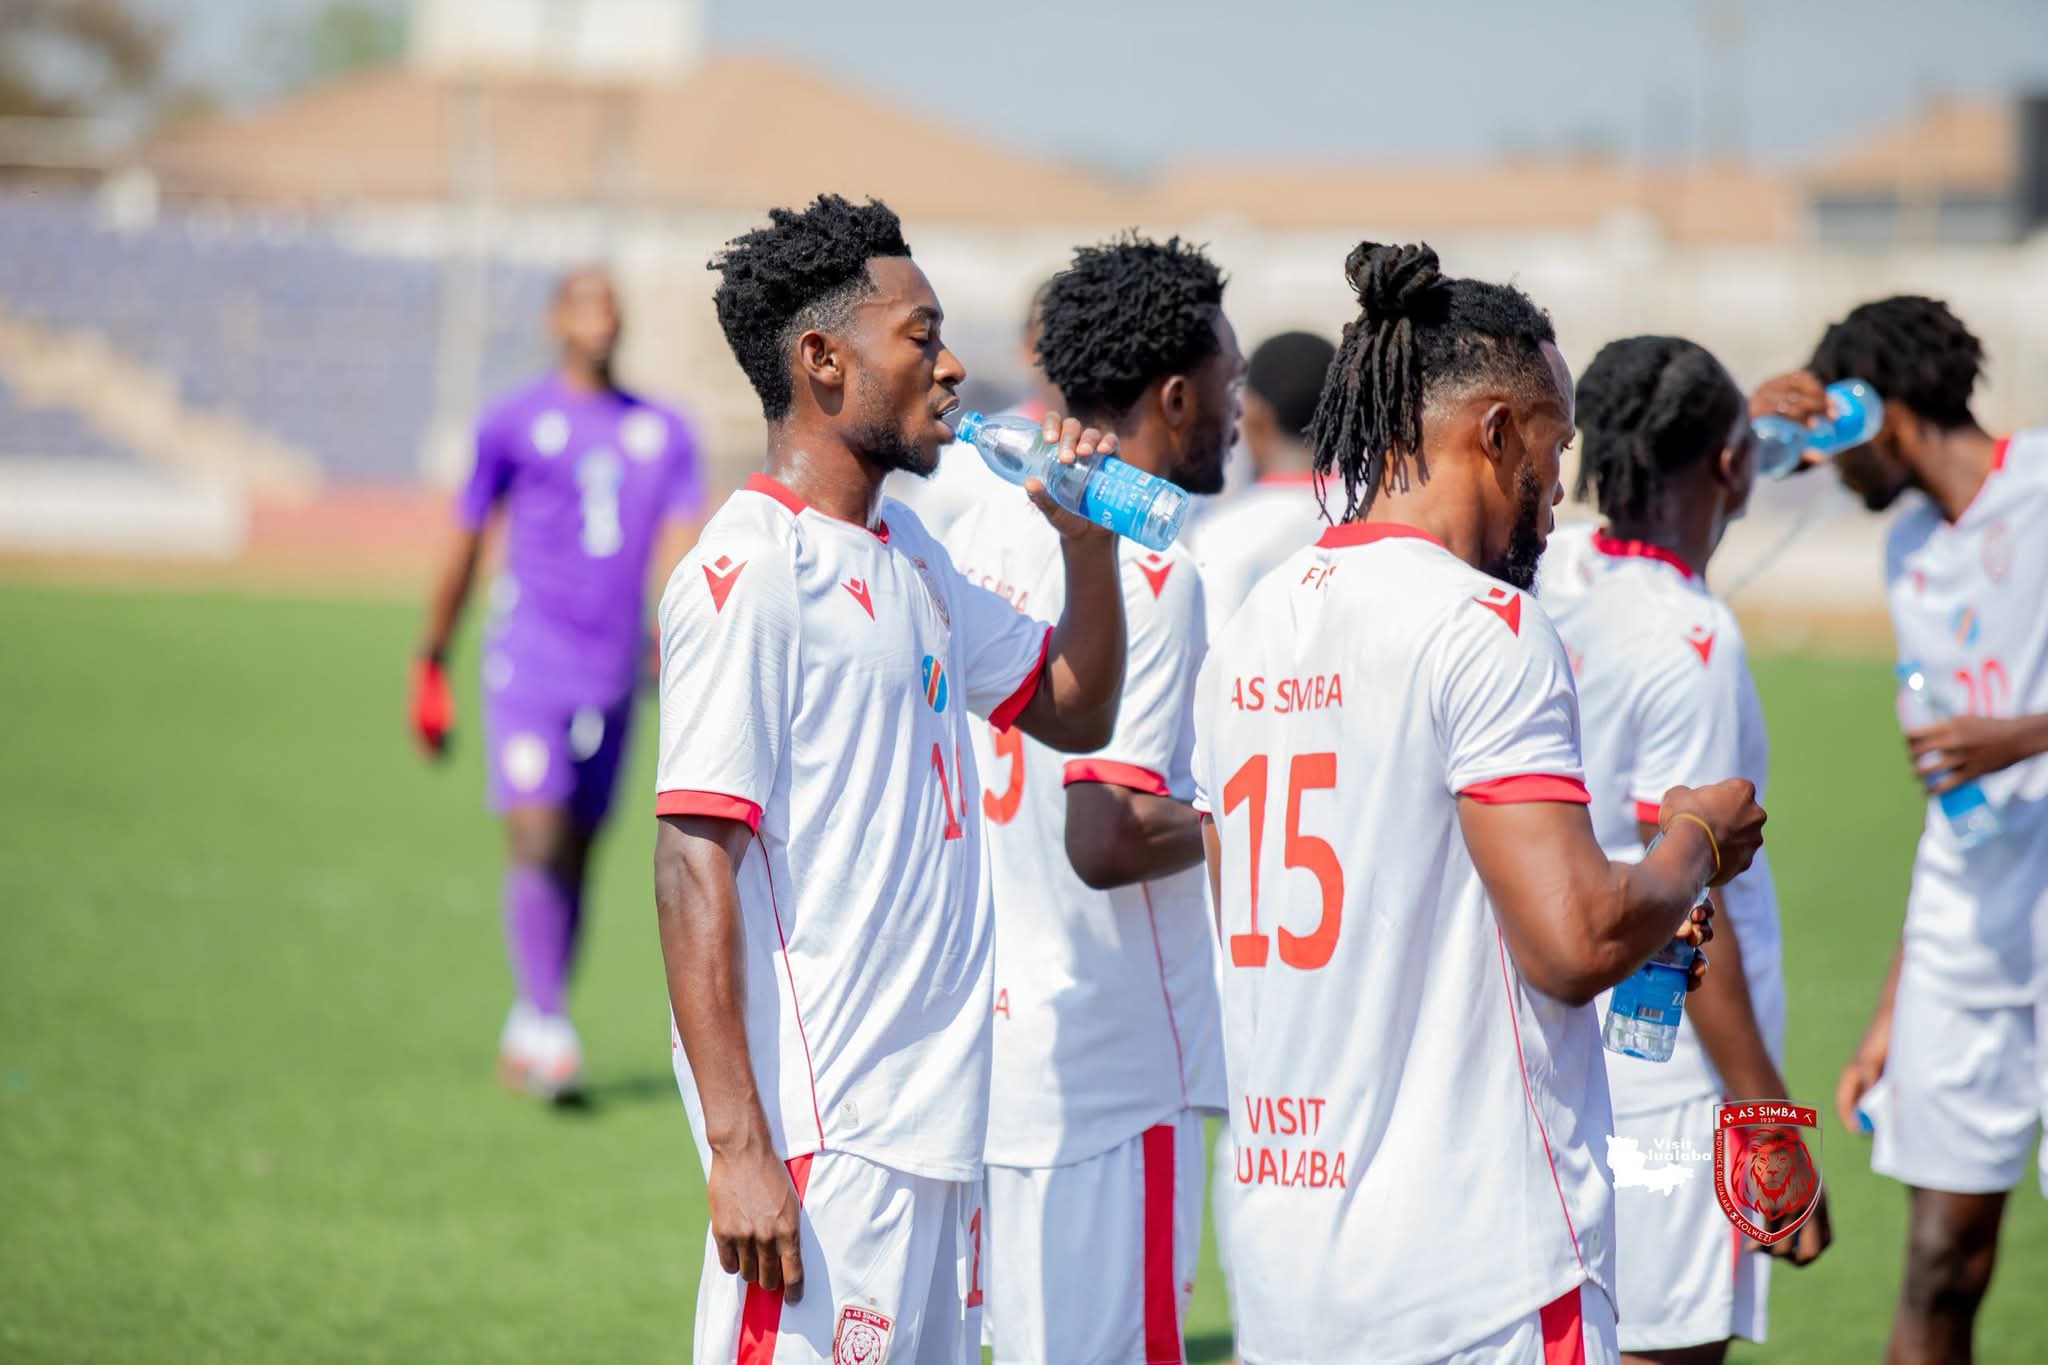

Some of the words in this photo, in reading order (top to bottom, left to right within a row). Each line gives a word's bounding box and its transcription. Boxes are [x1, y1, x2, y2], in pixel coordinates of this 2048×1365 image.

[1231, 677, 1265, 711] AS
[1273, 673, 1343, 714] SMBA
[1223, 752, 1345, 971] 15
[1245, 1095, 1326, 1136] VISIT
[1234, 1145, 1346, 1189] UALABA
